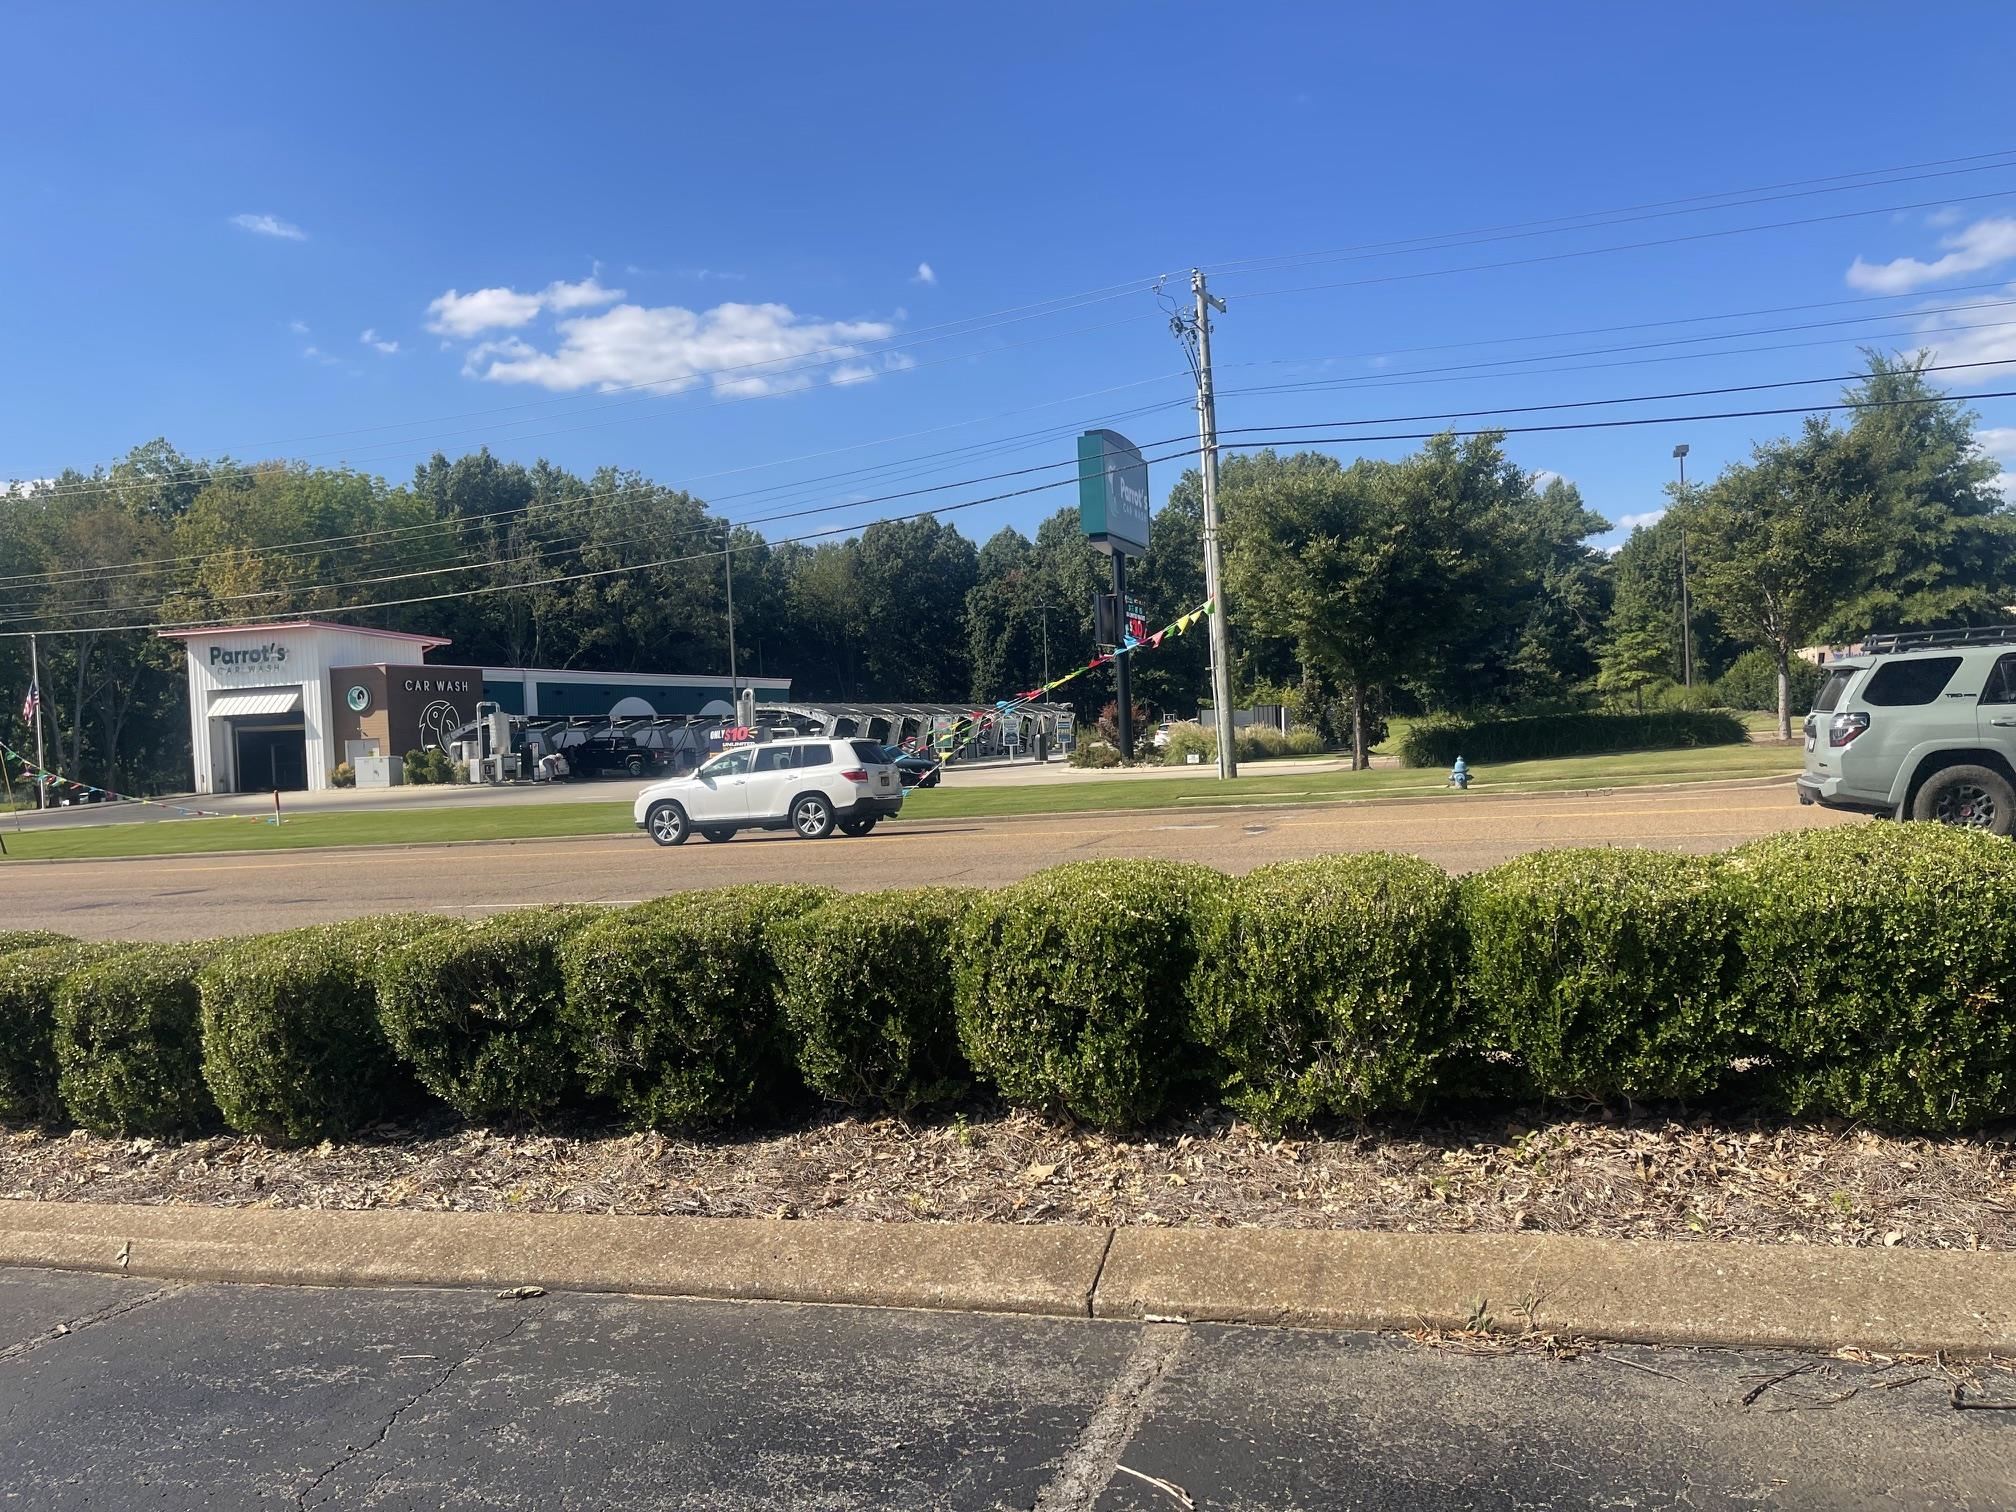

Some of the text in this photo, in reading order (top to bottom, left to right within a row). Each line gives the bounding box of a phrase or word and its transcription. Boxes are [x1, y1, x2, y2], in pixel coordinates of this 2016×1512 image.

[210, 643, 285, 665] Parrot's
[218, 664, 280, 675] CAR WASH
[405, 680, 468, 692] CAR WASH
[710, 726, 748, 741] ONLY $10
